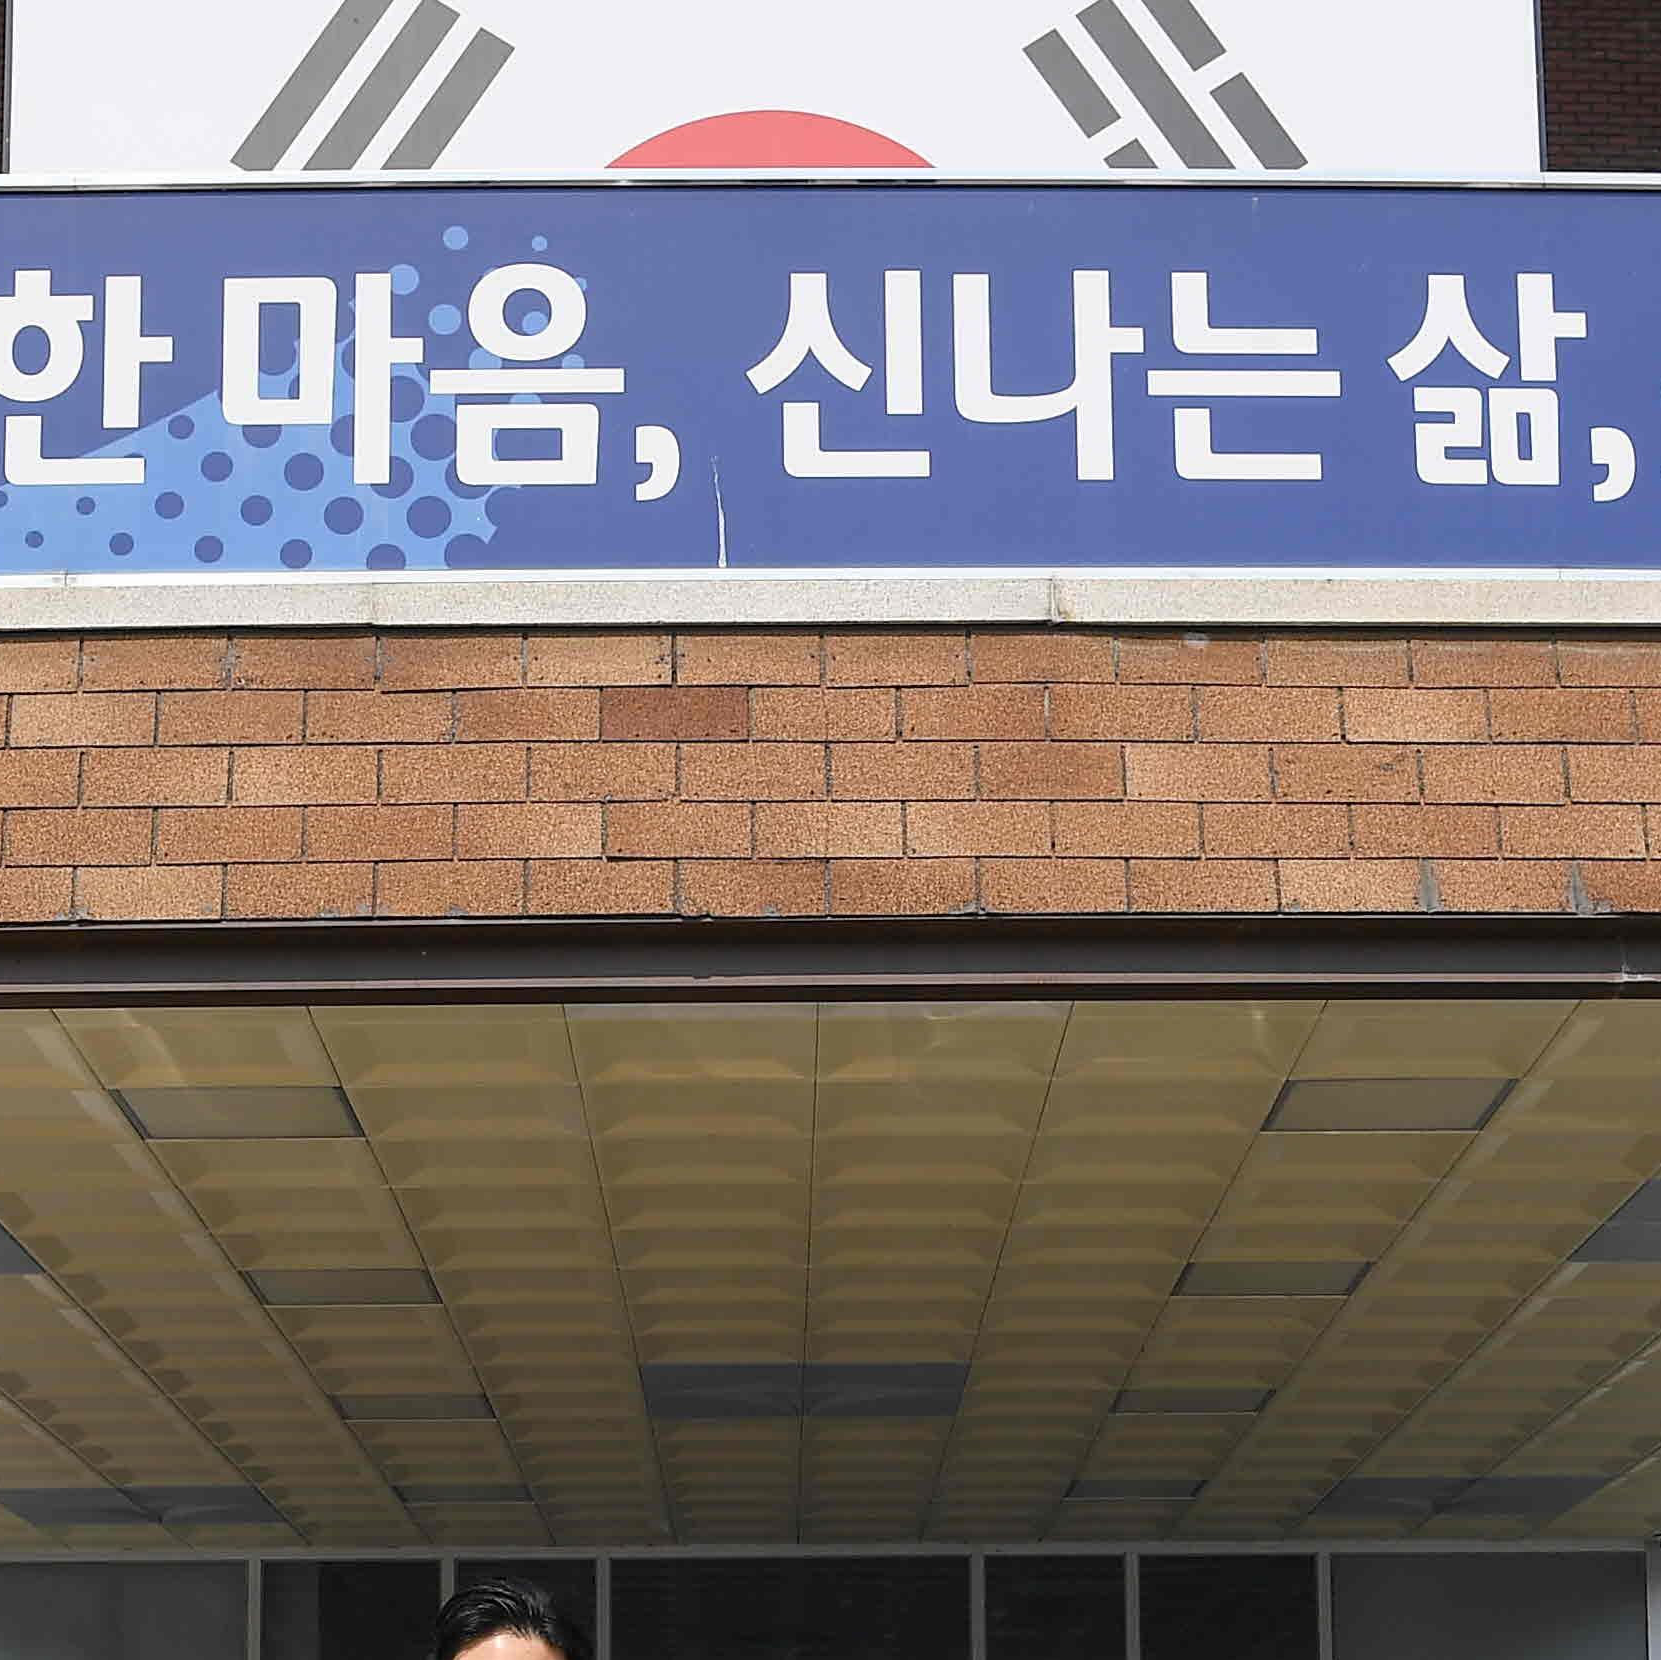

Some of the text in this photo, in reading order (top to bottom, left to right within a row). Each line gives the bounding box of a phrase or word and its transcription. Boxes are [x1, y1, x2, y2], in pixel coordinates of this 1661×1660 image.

[221, 262, 681, 502] 마음,
[745, 269, 1340, 480] 신나는
[1386, 273, 1636, 502] 삶,
